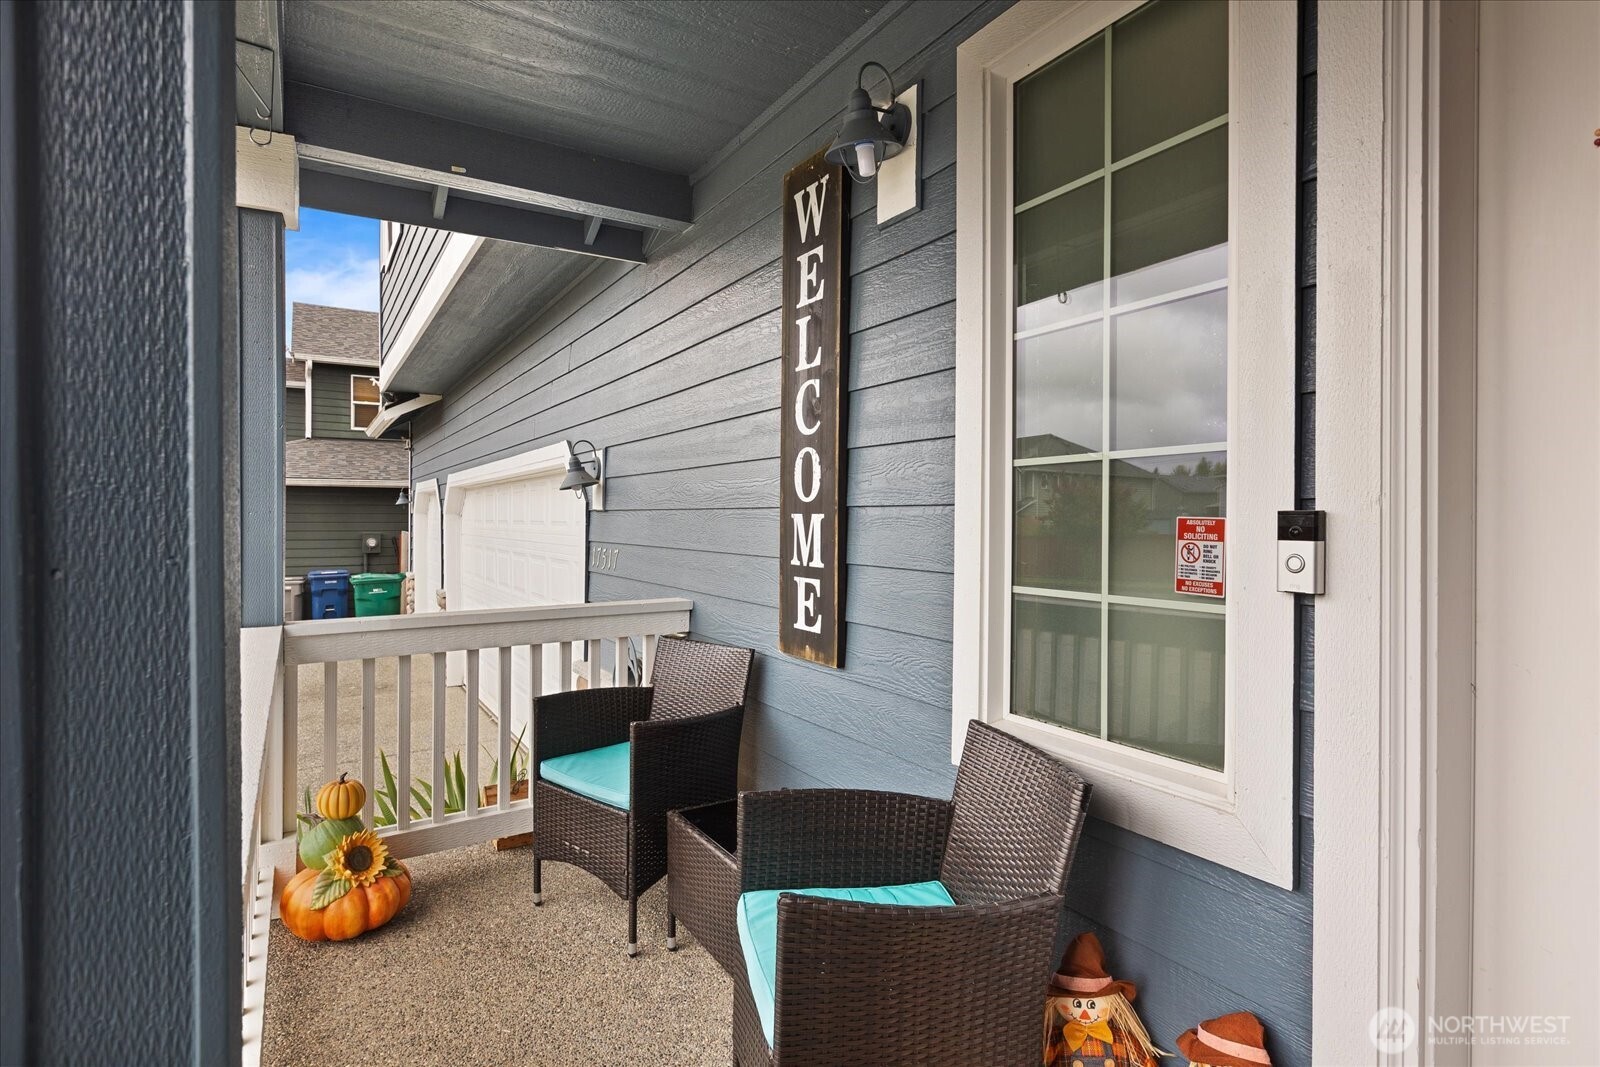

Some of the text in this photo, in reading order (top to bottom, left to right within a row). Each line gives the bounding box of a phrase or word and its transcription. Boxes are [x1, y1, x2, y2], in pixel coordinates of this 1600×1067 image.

[791, 174, 830, 635] WELCOME
[1196, 525, 1206, 533] NO
[1183, 532, 1218, 541] SOLICITING
[1189, 586, 1218, 594] EXCEPTIONS
